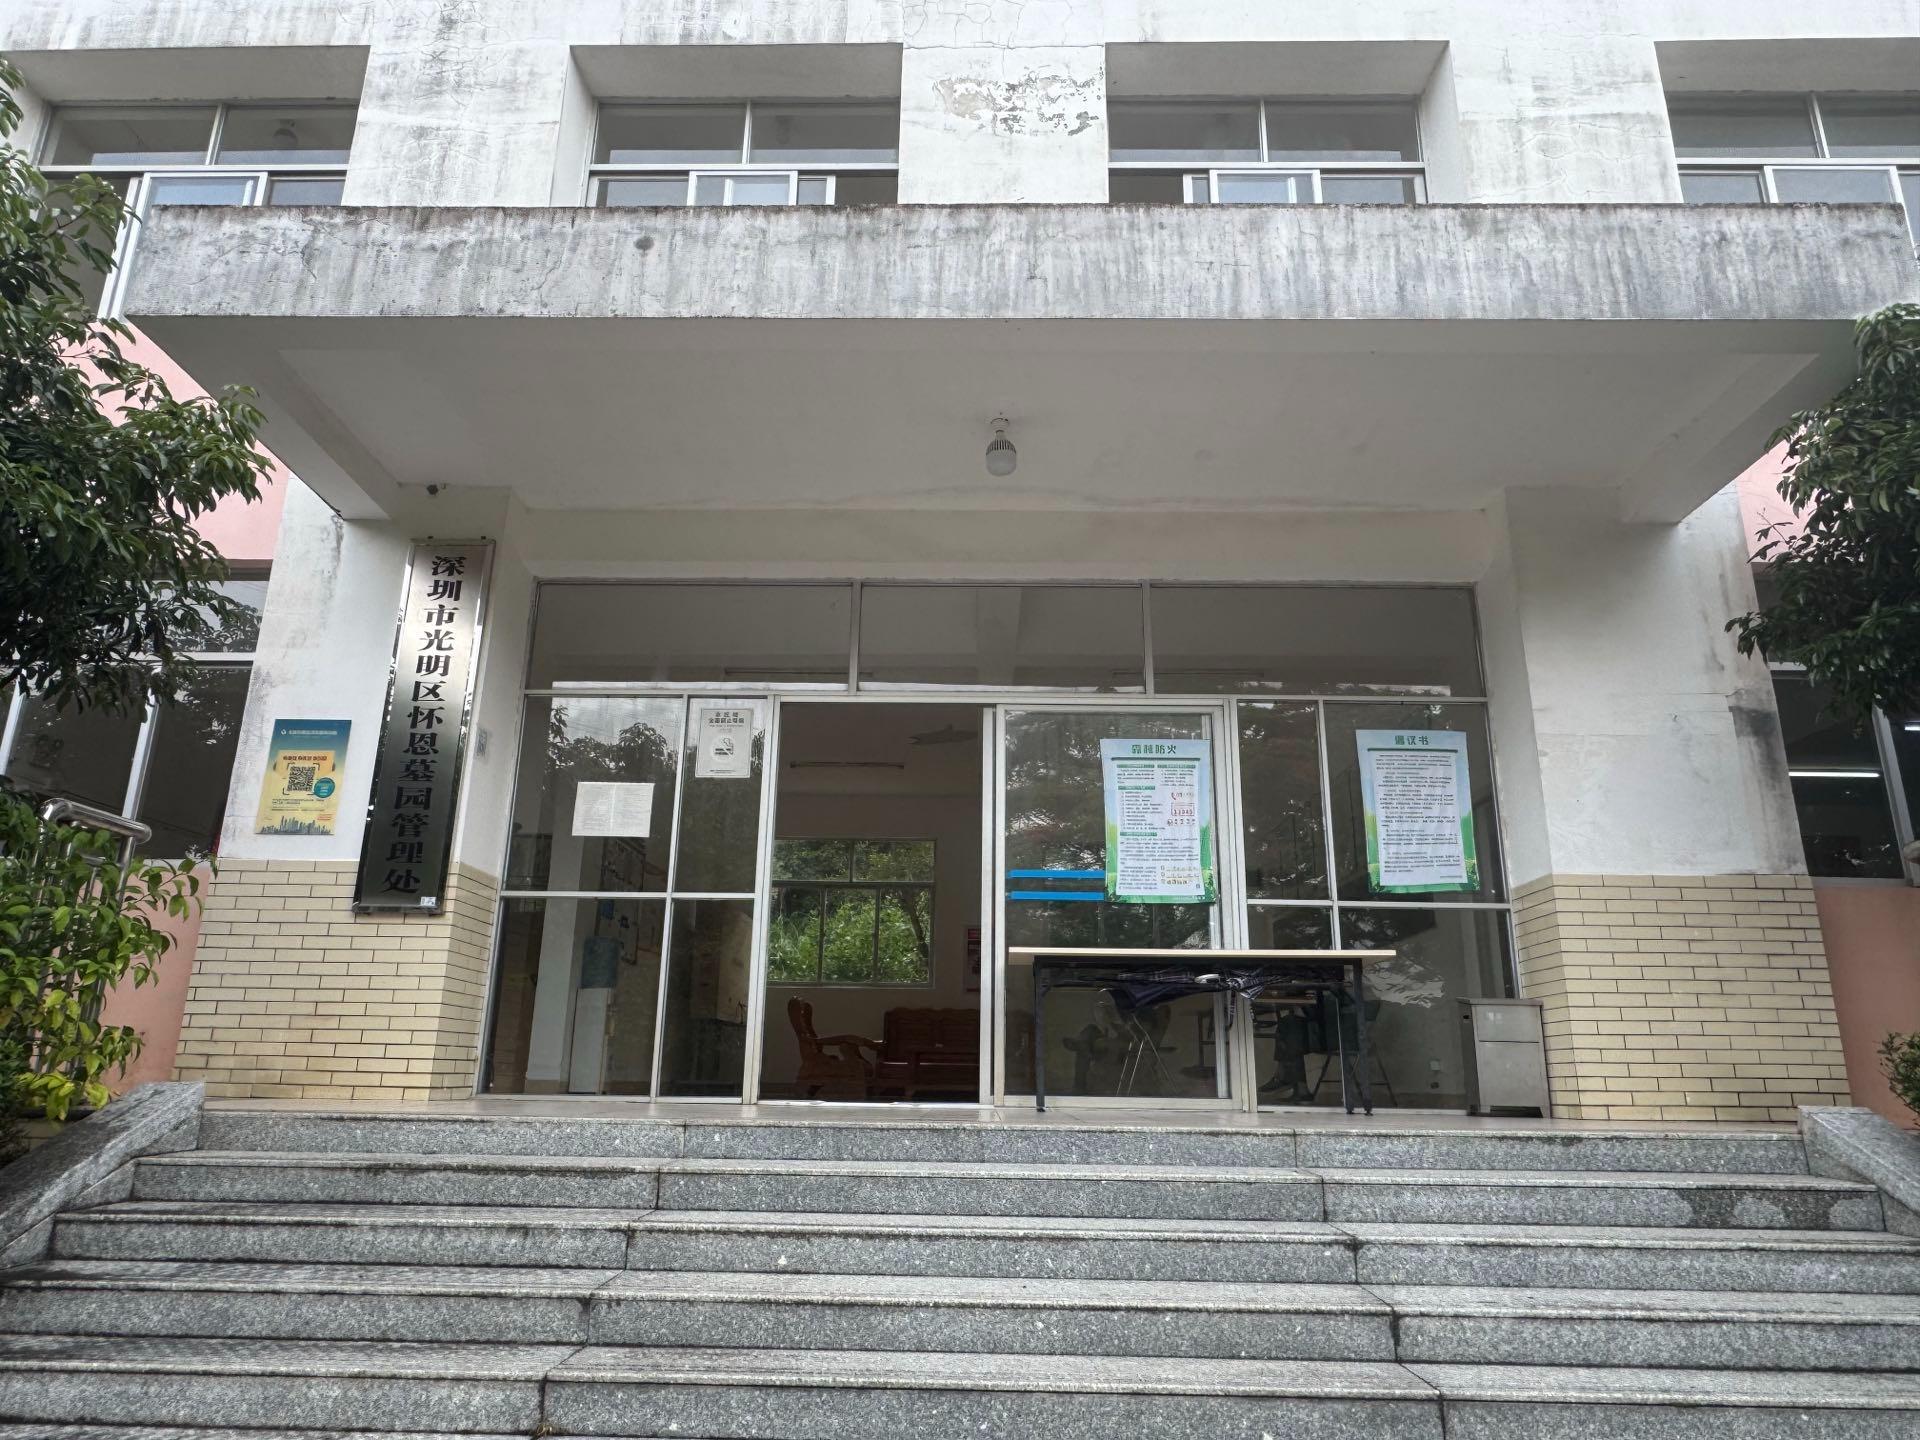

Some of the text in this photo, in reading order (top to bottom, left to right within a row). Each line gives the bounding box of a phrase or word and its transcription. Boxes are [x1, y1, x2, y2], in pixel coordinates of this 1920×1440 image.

[381, 555, 467, 894] 深圳市光明区怀恩墓园管理处
[1131, 744, 1177, 755] 森林防火
